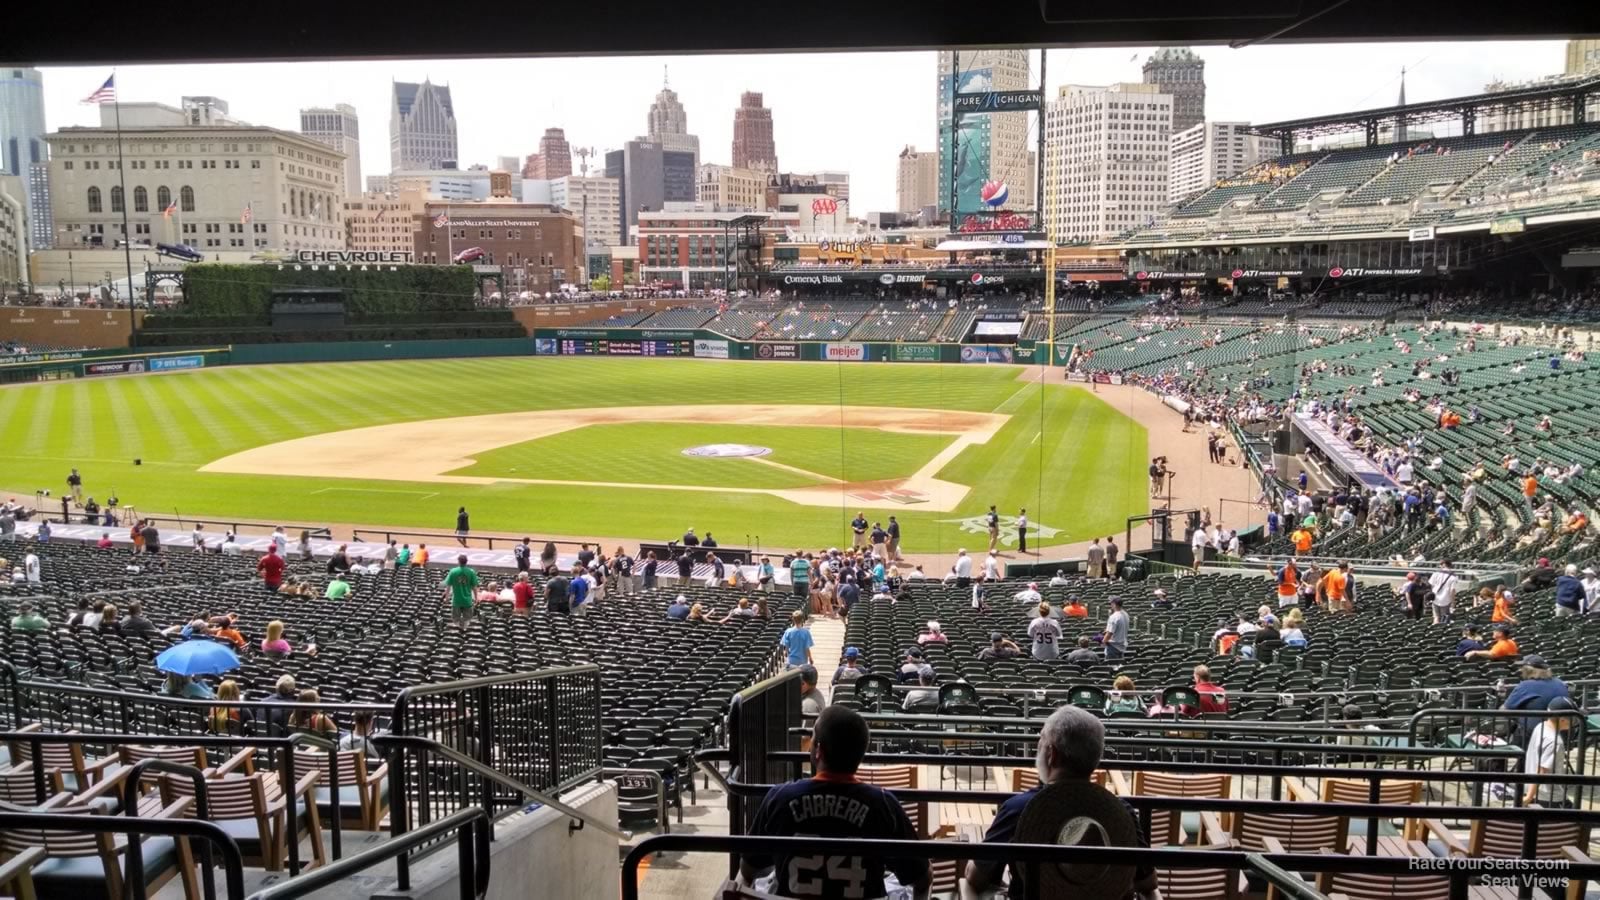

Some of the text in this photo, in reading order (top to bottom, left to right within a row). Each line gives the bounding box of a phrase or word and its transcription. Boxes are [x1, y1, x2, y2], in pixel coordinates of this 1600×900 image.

[956, 91, 1040, 111] PURE MICHIGAN
[813, 199, 837, 214] AAA
[300, 250, 412, 263] CHEVROLET
[1147, 271, 1163, 279] ATI
[1242, 270, 1258, 278] ATI
[1343, 268, 1364, 277] ATI
[822, 274, 843, 283] Bank
[896, 275, 926, 283] DETROIT
[984, 275, 1004, 284] pepsi
[829, 346, 860, 357] meijer
[897, 345, 934, 353] EASTERN
[621, 560, 628, 570] 2
[1036, 632, 1053, 645] 35
[789, 793, 870, 828] CABRERA
[788, 850, 865, 899] 24
